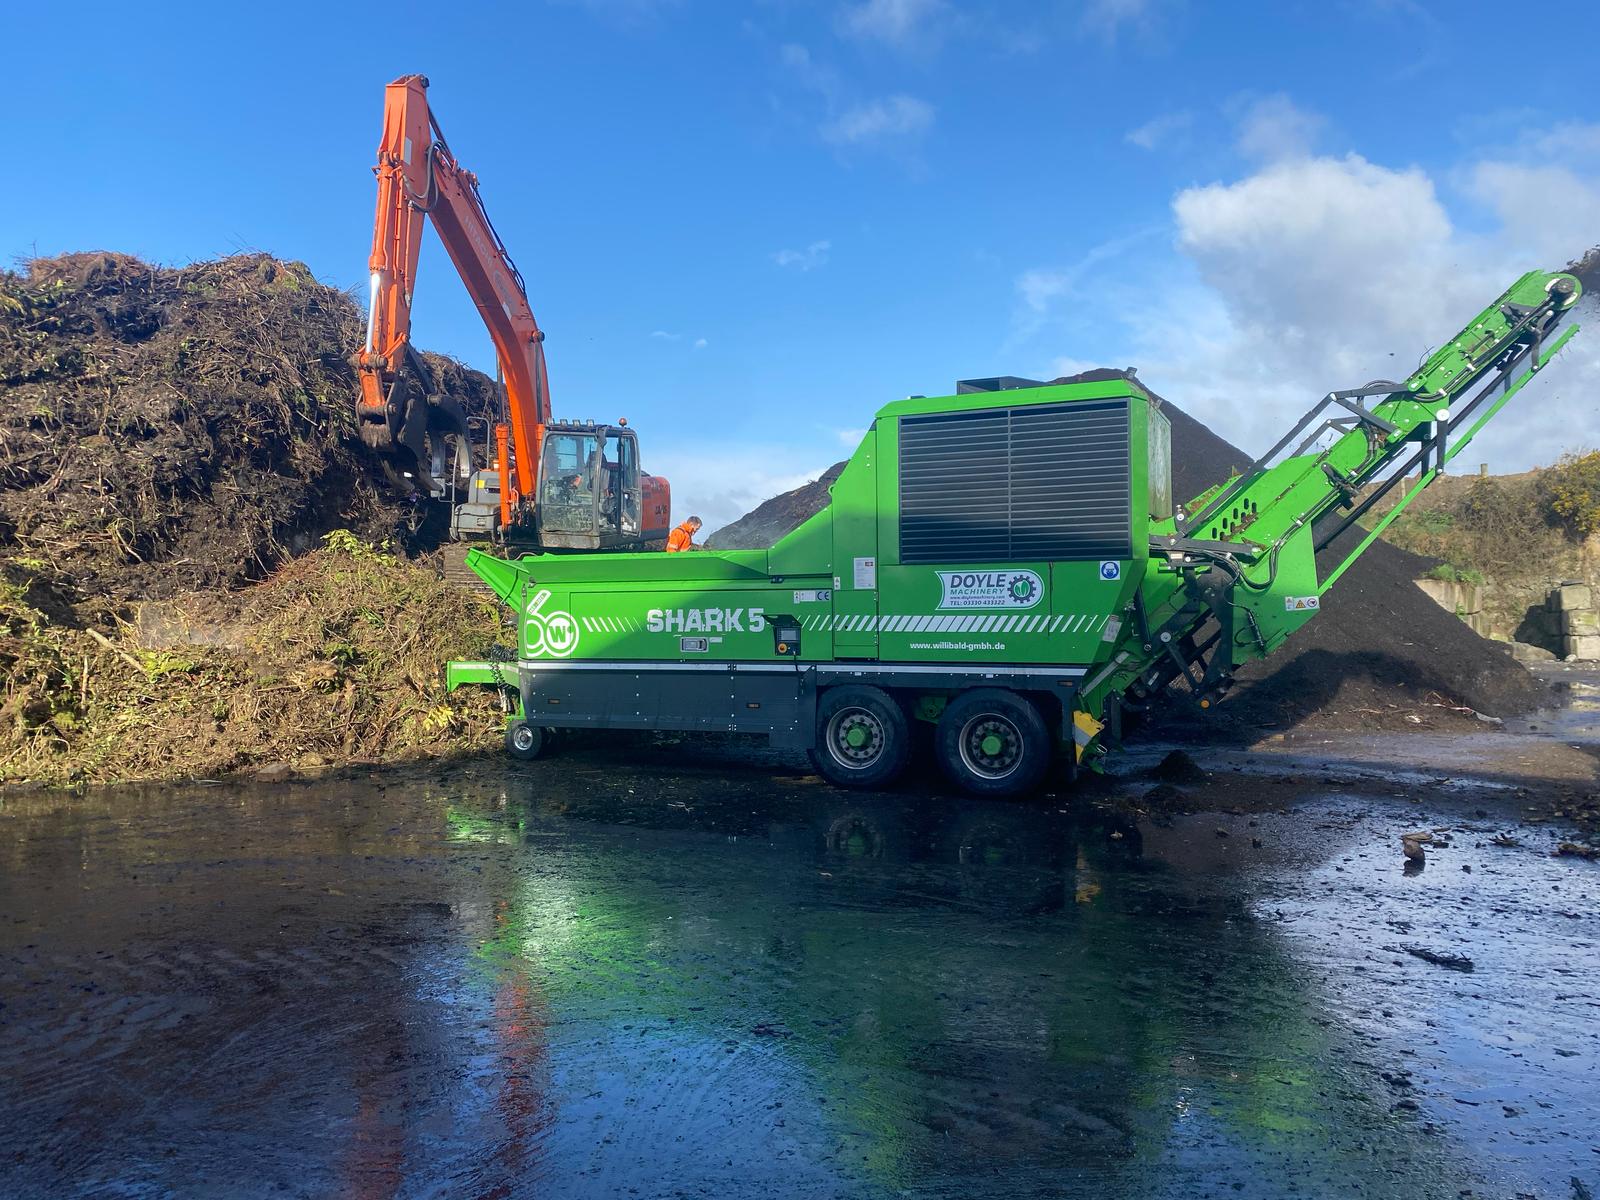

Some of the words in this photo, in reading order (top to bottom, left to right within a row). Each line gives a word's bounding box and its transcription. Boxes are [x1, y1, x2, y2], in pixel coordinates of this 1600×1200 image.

[950, 574, 1006, 588] DOYLE
[817, 591, 830, 601] CE
[646, 608, 744, 632] SHARK
[748, 608, 765, 633] 5
[910, 641, 1006, 652] www.willibald-gmbh.de
